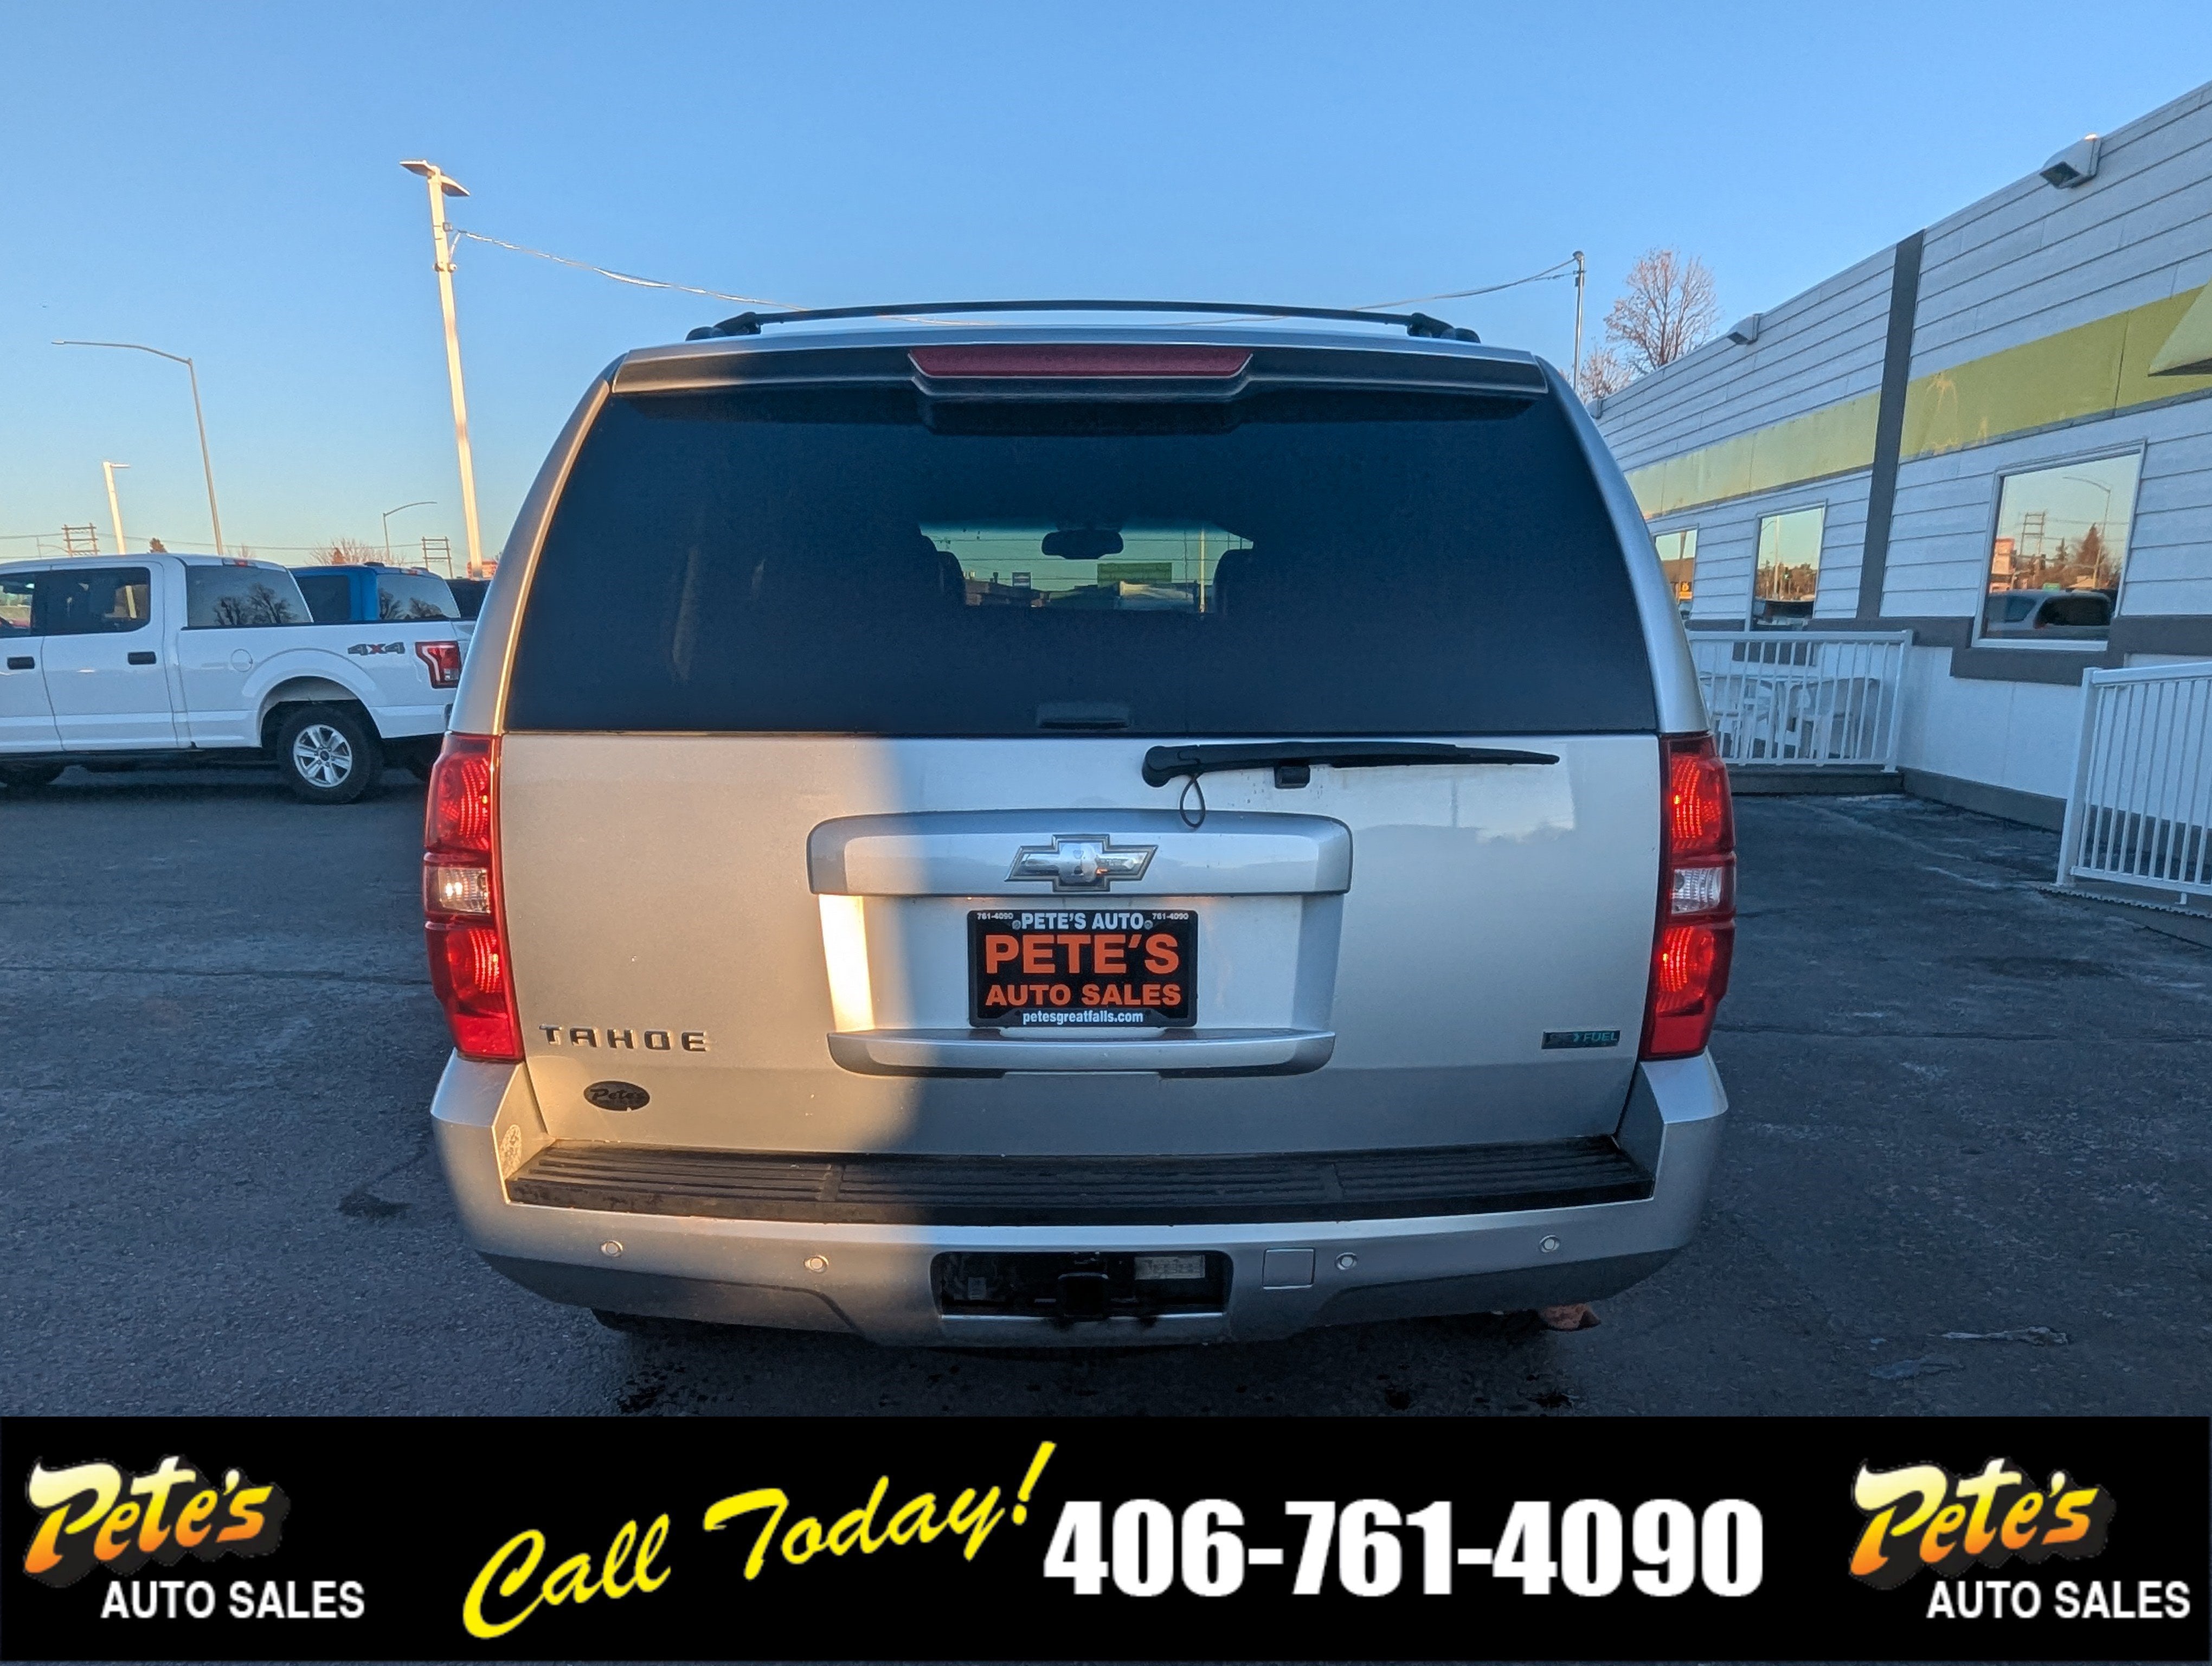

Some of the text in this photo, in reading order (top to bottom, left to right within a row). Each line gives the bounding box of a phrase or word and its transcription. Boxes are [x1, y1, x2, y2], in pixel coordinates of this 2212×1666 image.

[1021, 913, 1144, 930] PETE'S AUTO
[985, 933, 1179, 974] PETE'S
[986, 984, 1182, 1006] AUTO SALES
[1023, 1010, 1143, 1025] petesgreatfalls.com
[539, 1024, 710, 1052] TAHOE
